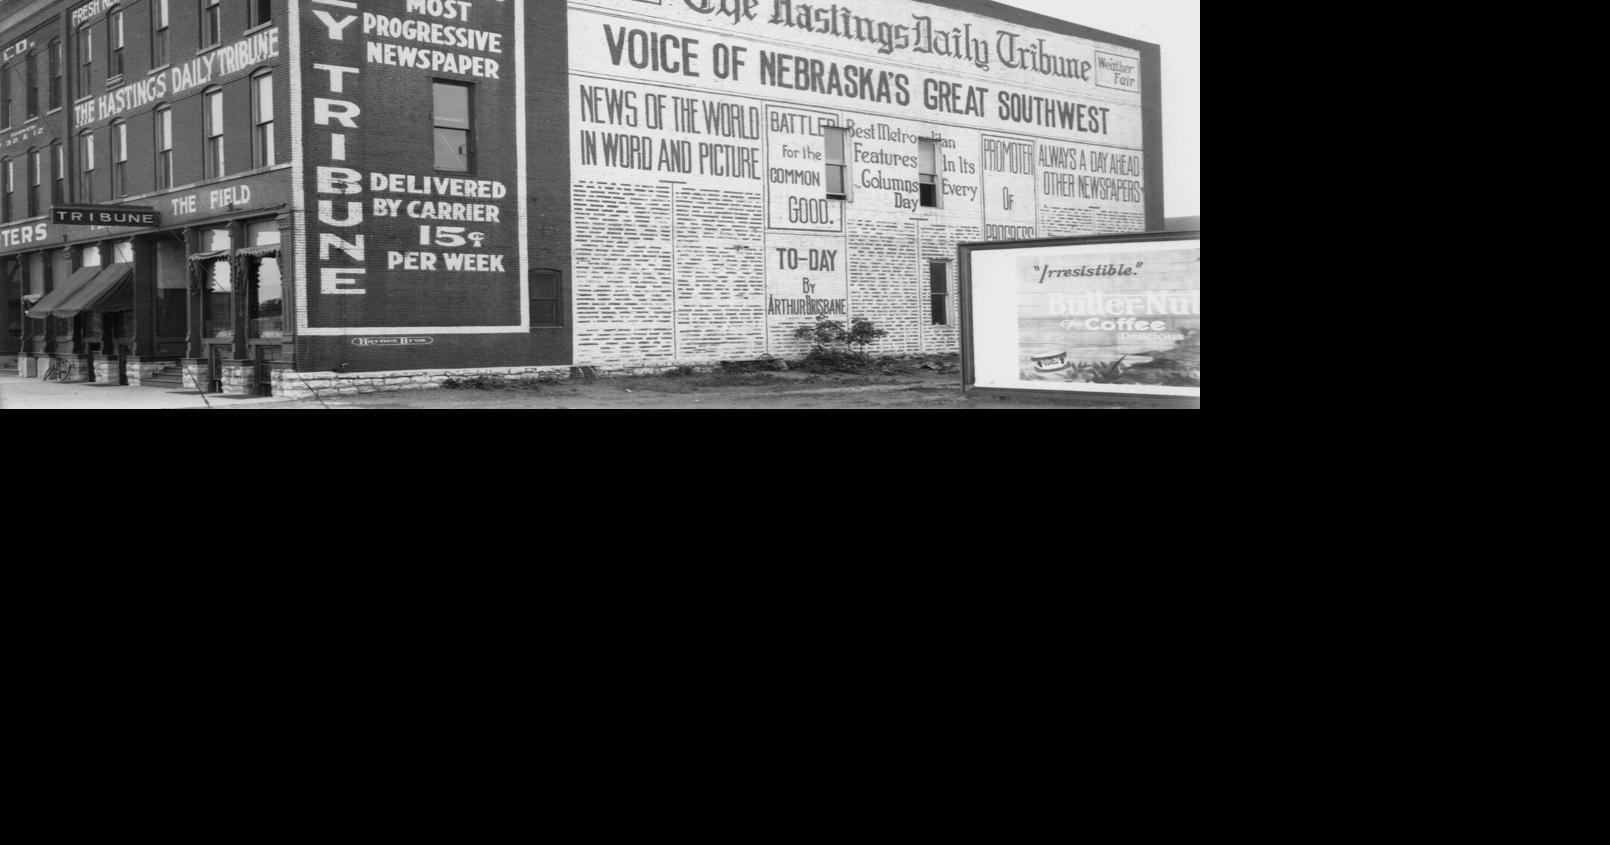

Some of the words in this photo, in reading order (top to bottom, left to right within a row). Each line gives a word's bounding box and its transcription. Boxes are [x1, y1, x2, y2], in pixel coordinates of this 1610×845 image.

[72, 0, 101, 27] FRESH
[406, 0, 472, 22] MOST
[363, 12, 503, 54] PROGRESSIVE
[768, 0, 910, 54] Hastings
[911, 12, 990, 72] Daily
[996, 29, 1092, 82] Tribune
[366, 41, 500, 80] NEWSPAPER
[1098, 56, 1135, 75] Weather
[75, 99, 96, 128] THE
[98, 73, 167, 121] HASTINGS
[171, 51, 216, 95] DAILY
[216, 26, 279, 77] TRIBUNE
[603, 23, 700, 78] VOICE
[712, 42, 747, 81] OF
[759, 49, 911, 107] NEBRASKA'S
[923, 77, 989, 118] GREAT
[998, 90, 1110, 136] SOUTHWEST
[1113, 72, 1136, 87] Fair
[580, 84, 638, 128] NEWS
[645, 93, 667, 131] OF
[671, 96, 701, 135] THE
[702, 99, 760, 141] WORLD
[845, 118, 875, 140] Best
[580, 130, 598, 166] IN
[601, 131, 652, 171] WORD
[657, 138, 692, 174] AND
[699, 142, 761, 180] PICTURE
[853, 141, 918, 169] Features
[942, 153, 956, 173] In
[958, 155, 976, 175] Its
[983, 138, 1034, 176] PROMOTER
[1039, 143, 1077, 171] ALWAYS
[1079, 149, 1087, 171] A
[1090, 150, 1109, 174] DAY
[1109, 153, 1140, 178] AHEAD
[313, 62, 366, 295] TRIBUNE
[370, 172, 507, 199] DELIVERED
[769, 167, 821, 187] COMMON
[861, 168, 919, 194] Columns
[941, 177, 978, 202] Every
[1043, 170, 1075, 198] OTHER
[1078, 174, 1141, 203] NEWSPAPERS
[172, 194, 197, 216] THE
[209, 184, 251, 210] FIELD
[373, 198, 403, 217] BY
[406, 200, 501, 223] CARRIER
[788, 195, 835, 224] GOOD.
[894, 191, 919, 213] Day
[56, 210, 154, 225] TRIBUNE
[419, 225, 486, 248] 15¢
[387, 251, 437, 272] PER
[442, 252, 506, 273] WEEK
[775, 247, 837, 272] TO-DAY
[1083, 316, 1167, 332] Coffee
